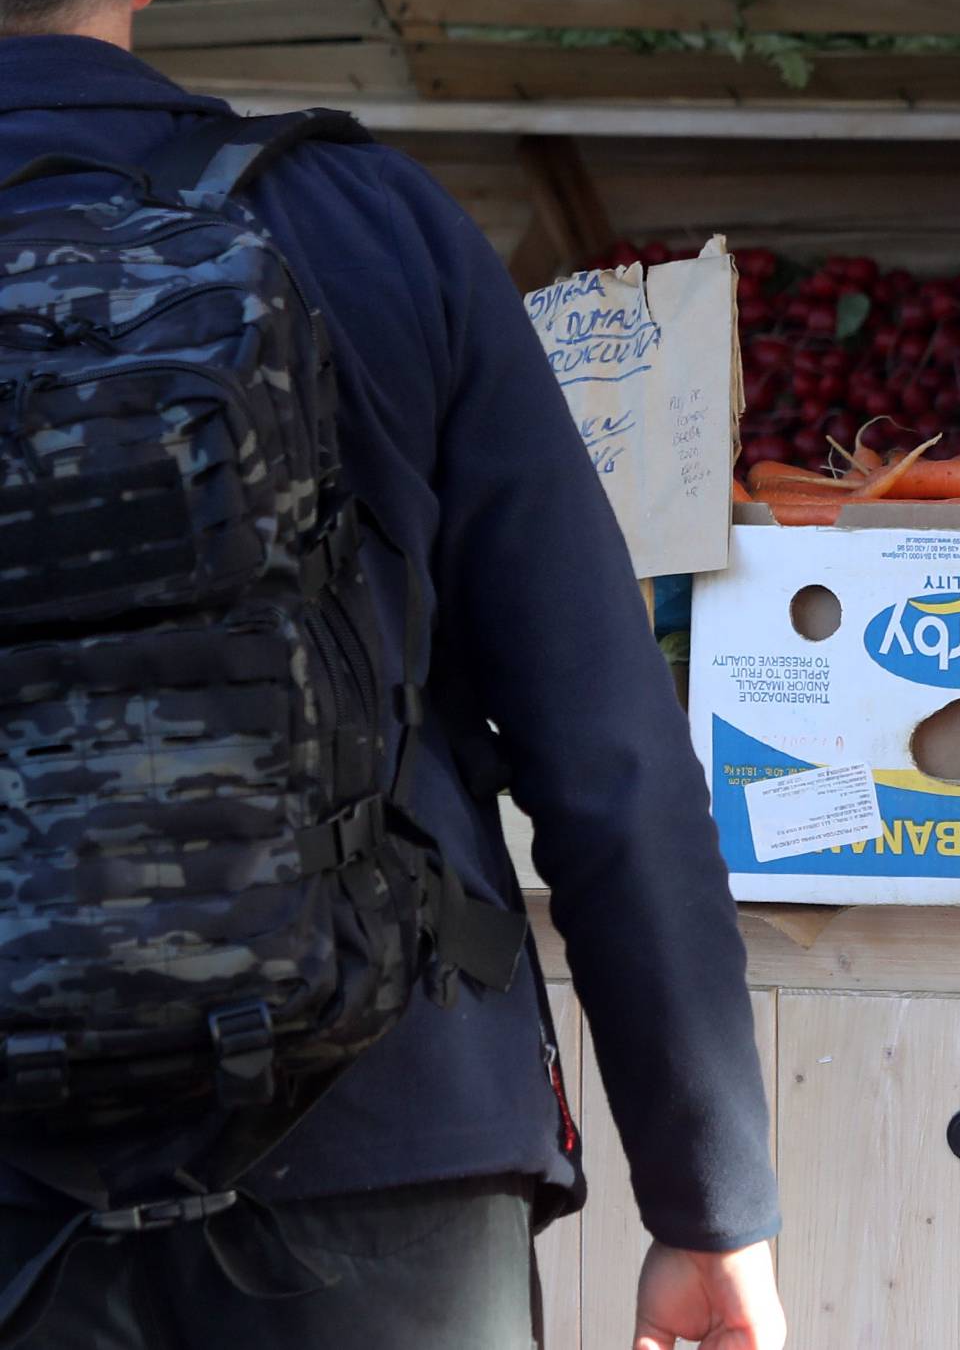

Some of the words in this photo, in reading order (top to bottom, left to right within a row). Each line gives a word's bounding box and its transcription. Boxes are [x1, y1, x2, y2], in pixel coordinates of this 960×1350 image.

[711, 655, 755, 666] QUALITY
[758, 656, 812, 668] PRESERVE
[814, 657, 830, 668] TO
[729, 667, 762, 678] FRUIT
[765, 668, 781, 679] TO
[783, 669, 830, 680] APPLIED
[735, 679, 784, 691] IMAZALIL
[787, 681, 830, 691] AND/OR
[738, 691, 830, 704] THIABENDAZOLE
